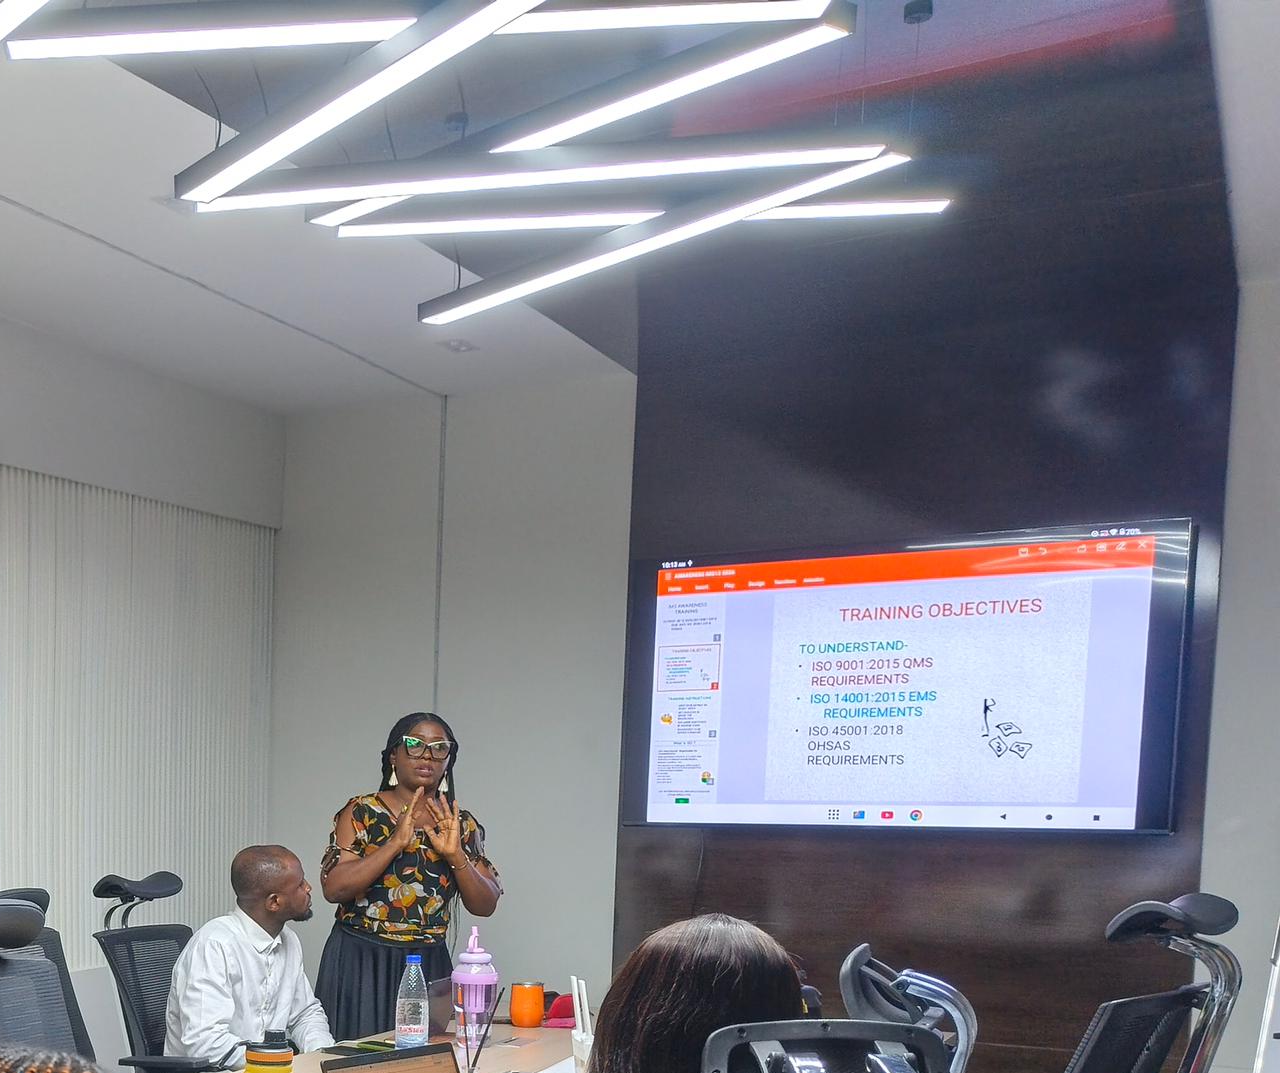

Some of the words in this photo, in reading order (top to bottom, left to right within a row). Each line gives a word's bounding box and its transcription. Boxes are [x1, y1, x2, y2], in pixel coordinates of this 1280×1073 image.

[839, 605, 924, 623] TRAINING
[928, 598, 1043, 619] OBJECTIVES
[799, 643, 816, 655] TO
[818, 640, 909, 655] UNDERSTAND-
[811, 660, 832, 672] ISO
[835, 658, 900, 671] 9001:2015
[902, 656, 934, 670] QMS
[811, 673, 910, 687] REQUIREMENTS
[810, 693, 831, 705] ISO
[833, 691, 905, 704] 14001:2015
[908, 690, 938, 703] EMS
[823, 706, 924, 719] REQUIREMENTS
[808, 725, 829, 737] ISO
[831, 724, 904, 736] 45001:2018
[807, 740, 851, 752] OHSAS
[807, 754, 906, 767] REQUIREMENTS
